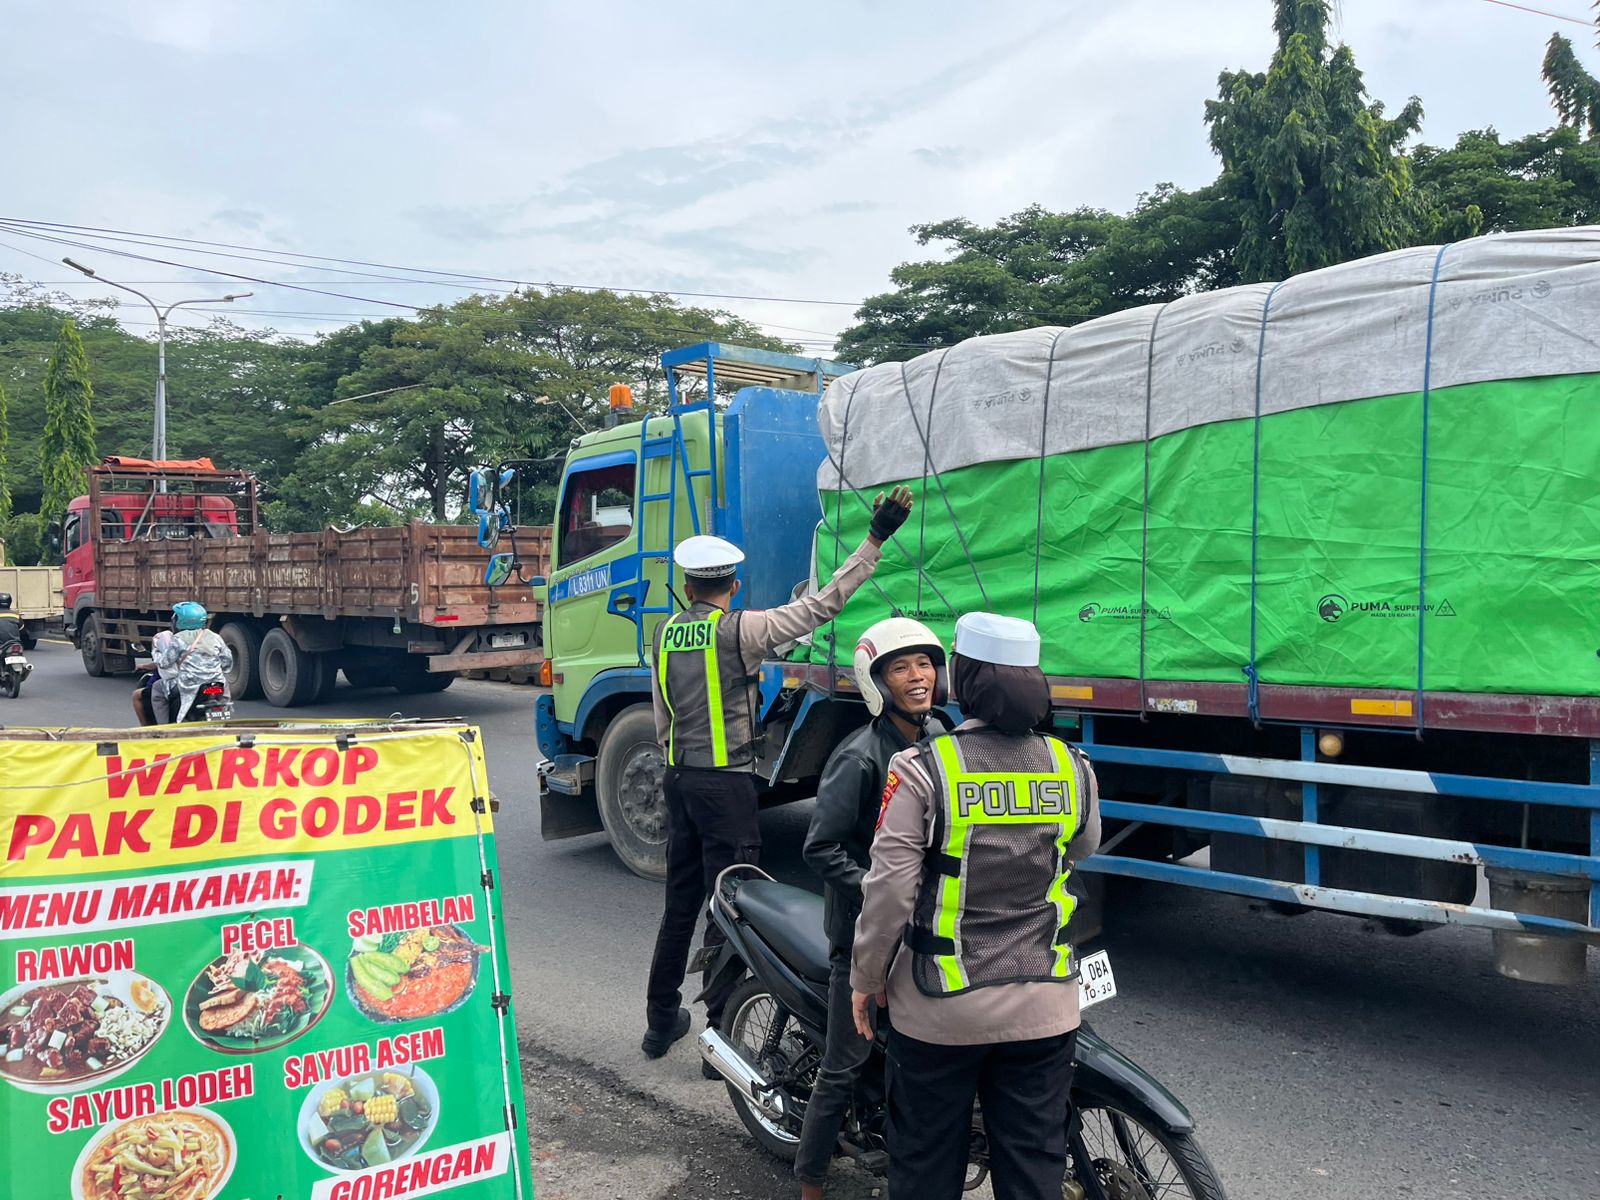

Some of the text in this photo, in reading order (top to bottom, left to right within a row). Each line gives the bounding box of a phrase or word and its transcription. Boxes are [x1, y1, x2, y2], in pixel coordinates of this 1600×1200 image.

[411, 582, 419, 604] 5
[573, 578, 579, 595] L
[579, 573, 595, 593] 8311
[595, 569, 608, 588] UN
[1351, 602, 1390, 611] PUMA
[663, 623, 712, 649] POLISI
[106, 747, 379, 799] WARKOP
[956, 780, 1072, 817] POLISI
[7, 787, 456, 861] PAK DI GODEK
[0, 868, 302, 931] MENU MAKANAN:
[347, 895, 475, 938] SAMBELAN
[222, 918, 297, 954] PECEL
[16, 939, 134, 982] RAWON
[284, 1028, 445, 1088] SAYUR ASEM
[48, 1064, 253, 1133] SAYUR LODEH
[329, 1141, 497, 1200] GORENGAN
